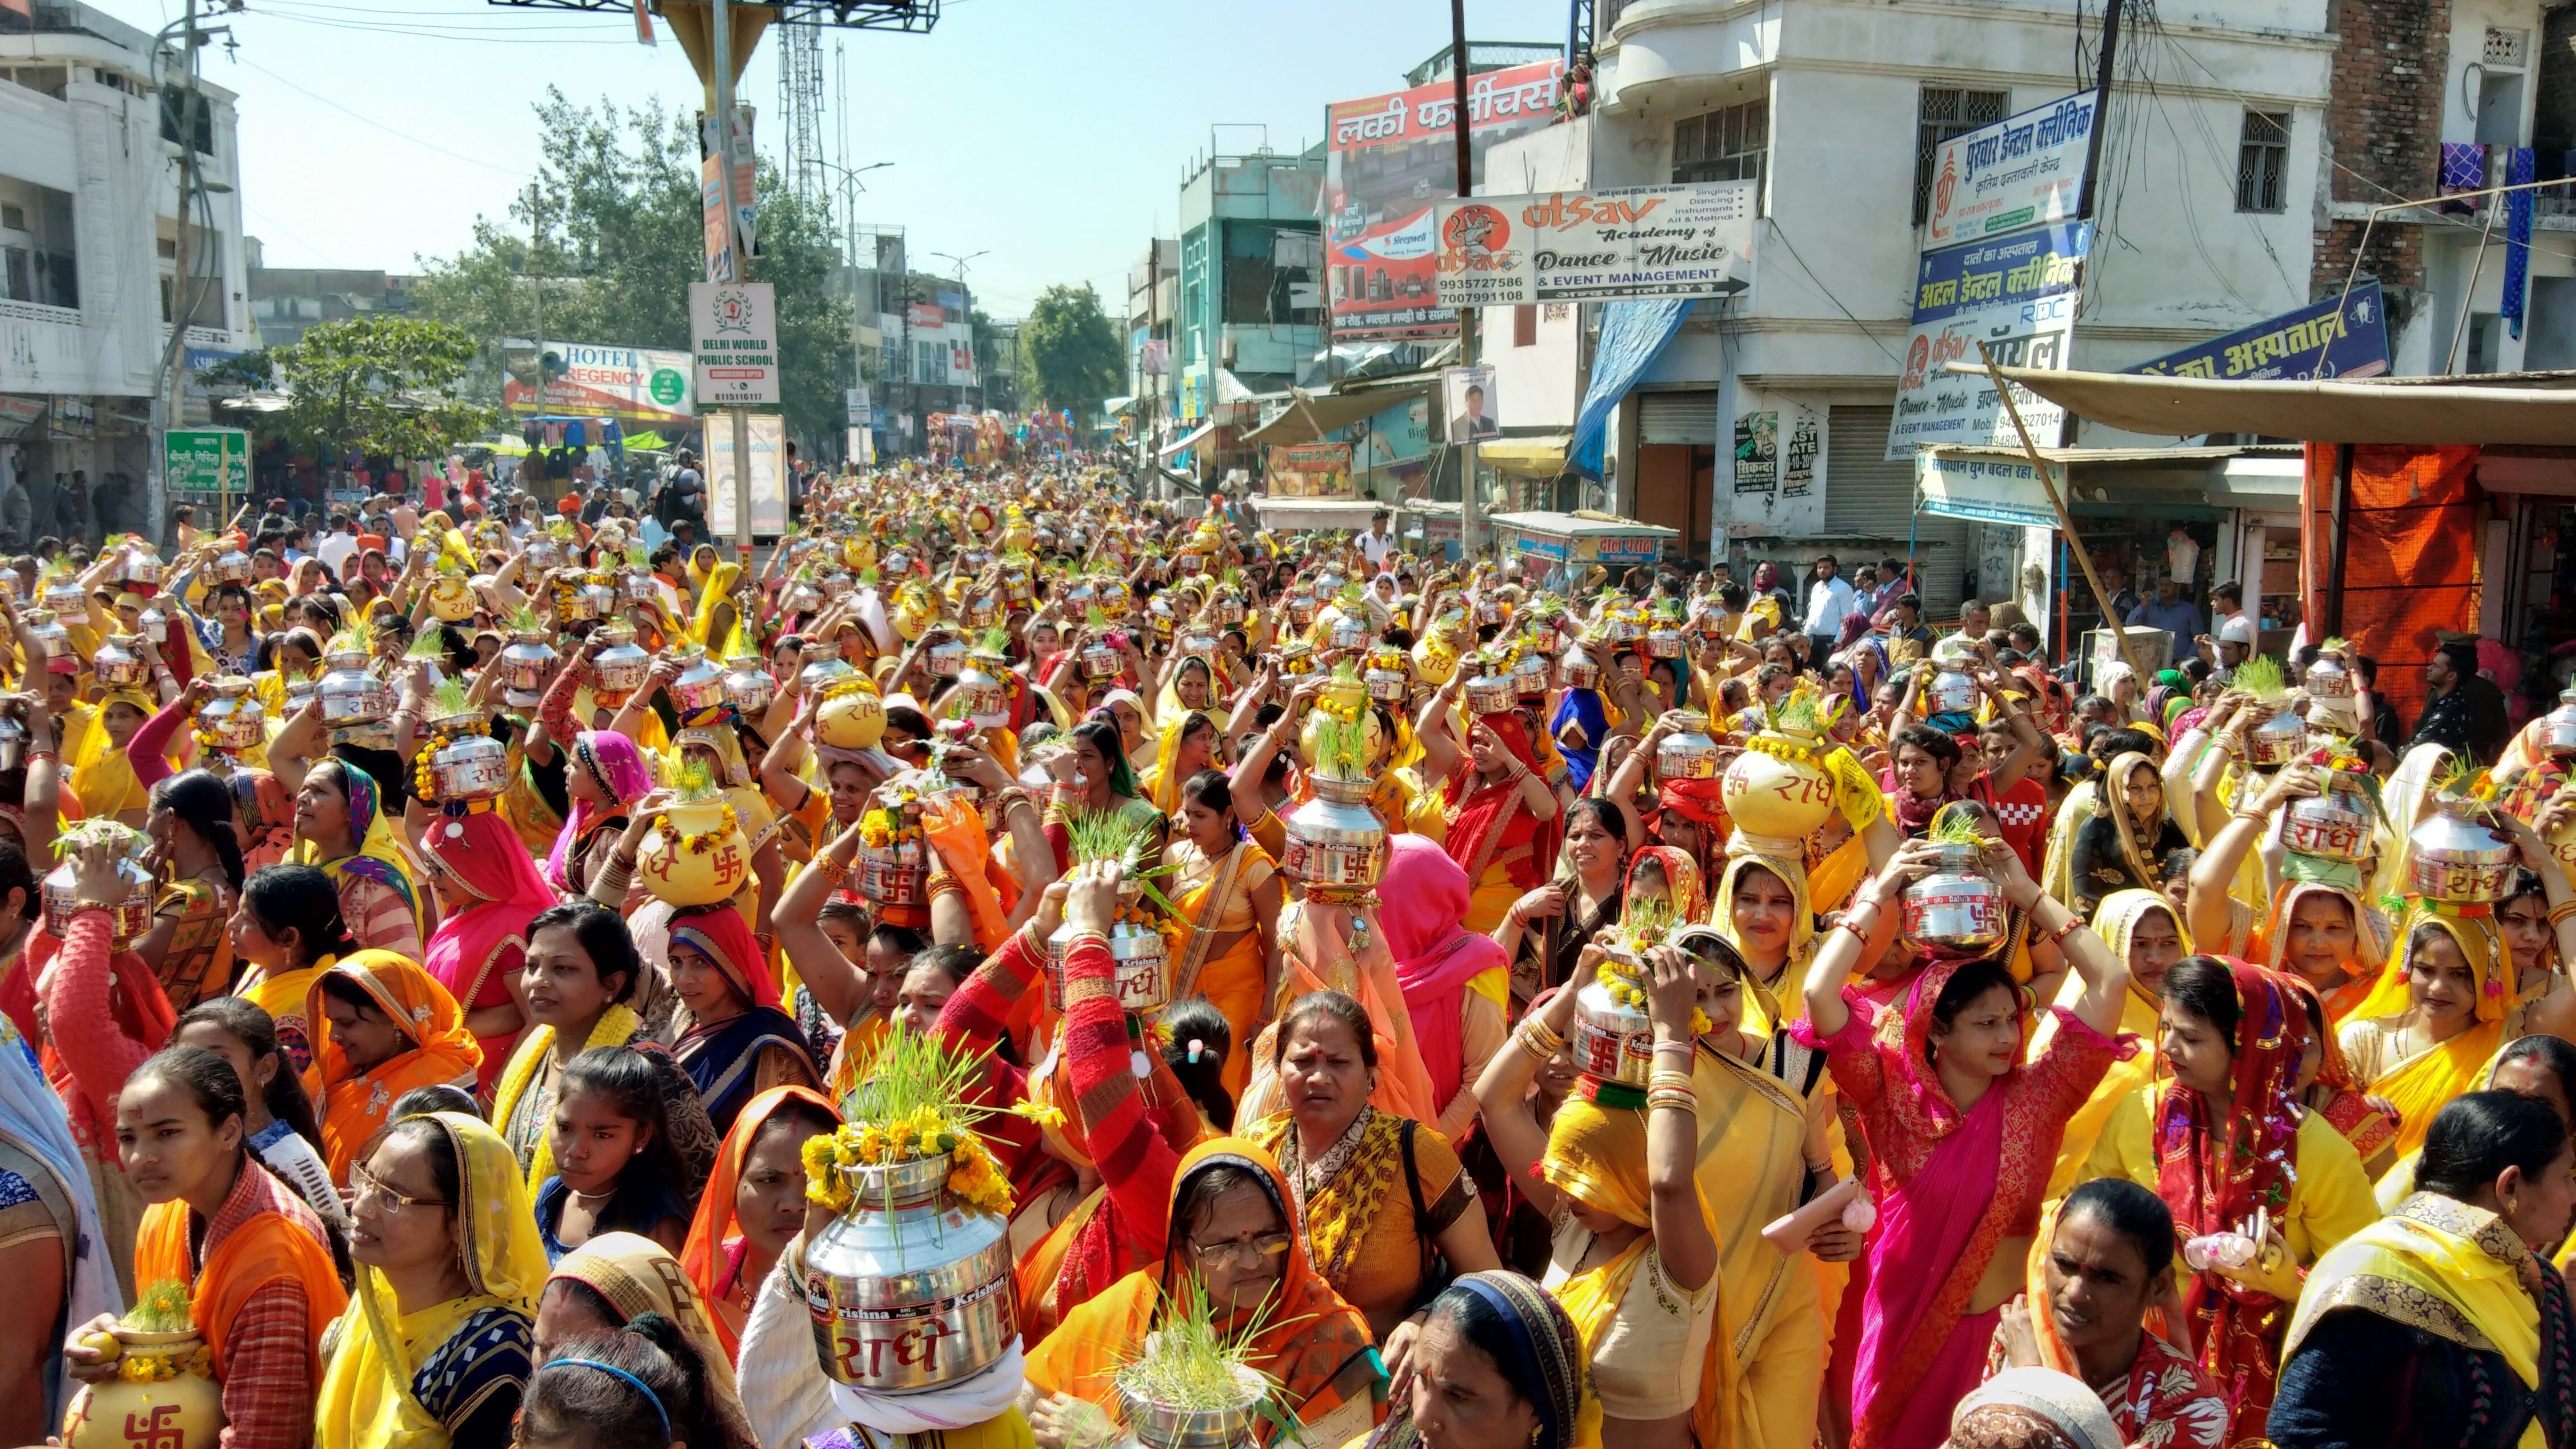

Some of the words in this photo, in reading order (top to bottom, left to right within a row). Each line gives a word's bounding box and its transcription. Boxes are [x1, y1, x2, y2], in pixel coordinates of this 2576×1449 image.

[1337, 96, 1409, 145] लकी
[1964, 133, 1999, 184] पुरवार
[1999, 123, 2034, 163] डेन्टल
[2037, 101, 2092, 151] क्लीनिक
[2000, 159, 2039, 187] दन्तावली
[2040, 156, 2061, 174] केन्द्र
[1696, 187, 1734, 197] Singing
[1334, 194, 1344, 209] 20
[1393, 233, 1426, 246] Sleepwell
[1596, 226, 1696, 243] Academy
[1703, 226, 1717, 237] of
[1533, 250, 1621, 272] Dance
[1637, 240, 1729, 268] Music
[1984, 247, 1997, 261] का
[1997, 240, 2039, 261] अस्पताल
[1439, 277, 1523, 289] 9935727586
[1538, 277, 1547, 286] &
[1554, 274, 1603, 286] EVENT
[1608, 269, 1720, 283] MANAGEMENT
[1441, 290, 1523, 304] 7007991108
[1919, 280, 1957, 310] अटल
[1960, 269, 2003, 302] डेन्टल
[1392, 309, 1414, 323] मण्डी
[2020, 299, 2066, 324] RDC
[703, 339, 730, 349] DELHI
[732, 339, 767, 349] WORLD
[2224, 312, 2348, 377] अस्पताल
[567, 347, 637, 368] HOTEL
[698, 355, 733, 365] PUBLIC
[735, 355, 774, 365] SCHOOL
[566, 367, 645, 386] REGENCY
[518, 392, 532, 402] Ac
[543, 386, 586, 398] Available
[1900, 397, 1930, 418] Dance
[1936, 390, 1969, 414] Music
[1895, 427, 1899, 435] &
[1901, 423, 1921, 434] EVENT
[1921, 419, 1966, 432] MANAGEMENT
[2000, 413, 2059, 429] 94527014
[1791, 442, 1816, 454] ATE
[1983, 433, 2041, 447] 739480224
[1932, 458, 1967, 473] सावधान
[1970, 462, 1985, 480] युग
[1988, 463, 2013, 477] बदल
[2016, 465, 2032, 479] रहा
[1600, 538, 1622, 553] दाल
[1625, 538, 1654, 553] पराठा
[1773, 768, 1833, 808] राधे
[2293, 819, 2359, 856] राधे
[1325, 844, 1358, 852] Krishna
[865, 859, 893, 868] Krishna
[2447, 871, 2506, 896] राधे
[1122, 958, 1158, 967] Krishna
[1115, 967, 1158, 1001] ाधे
[1578, 1019, 1607, 1036] Krishna
[954, 1277, 1005, 1308] Krishna
[839, 1308, 890, 1320] rishna
[835, 1318, 962, 1379] राधे
